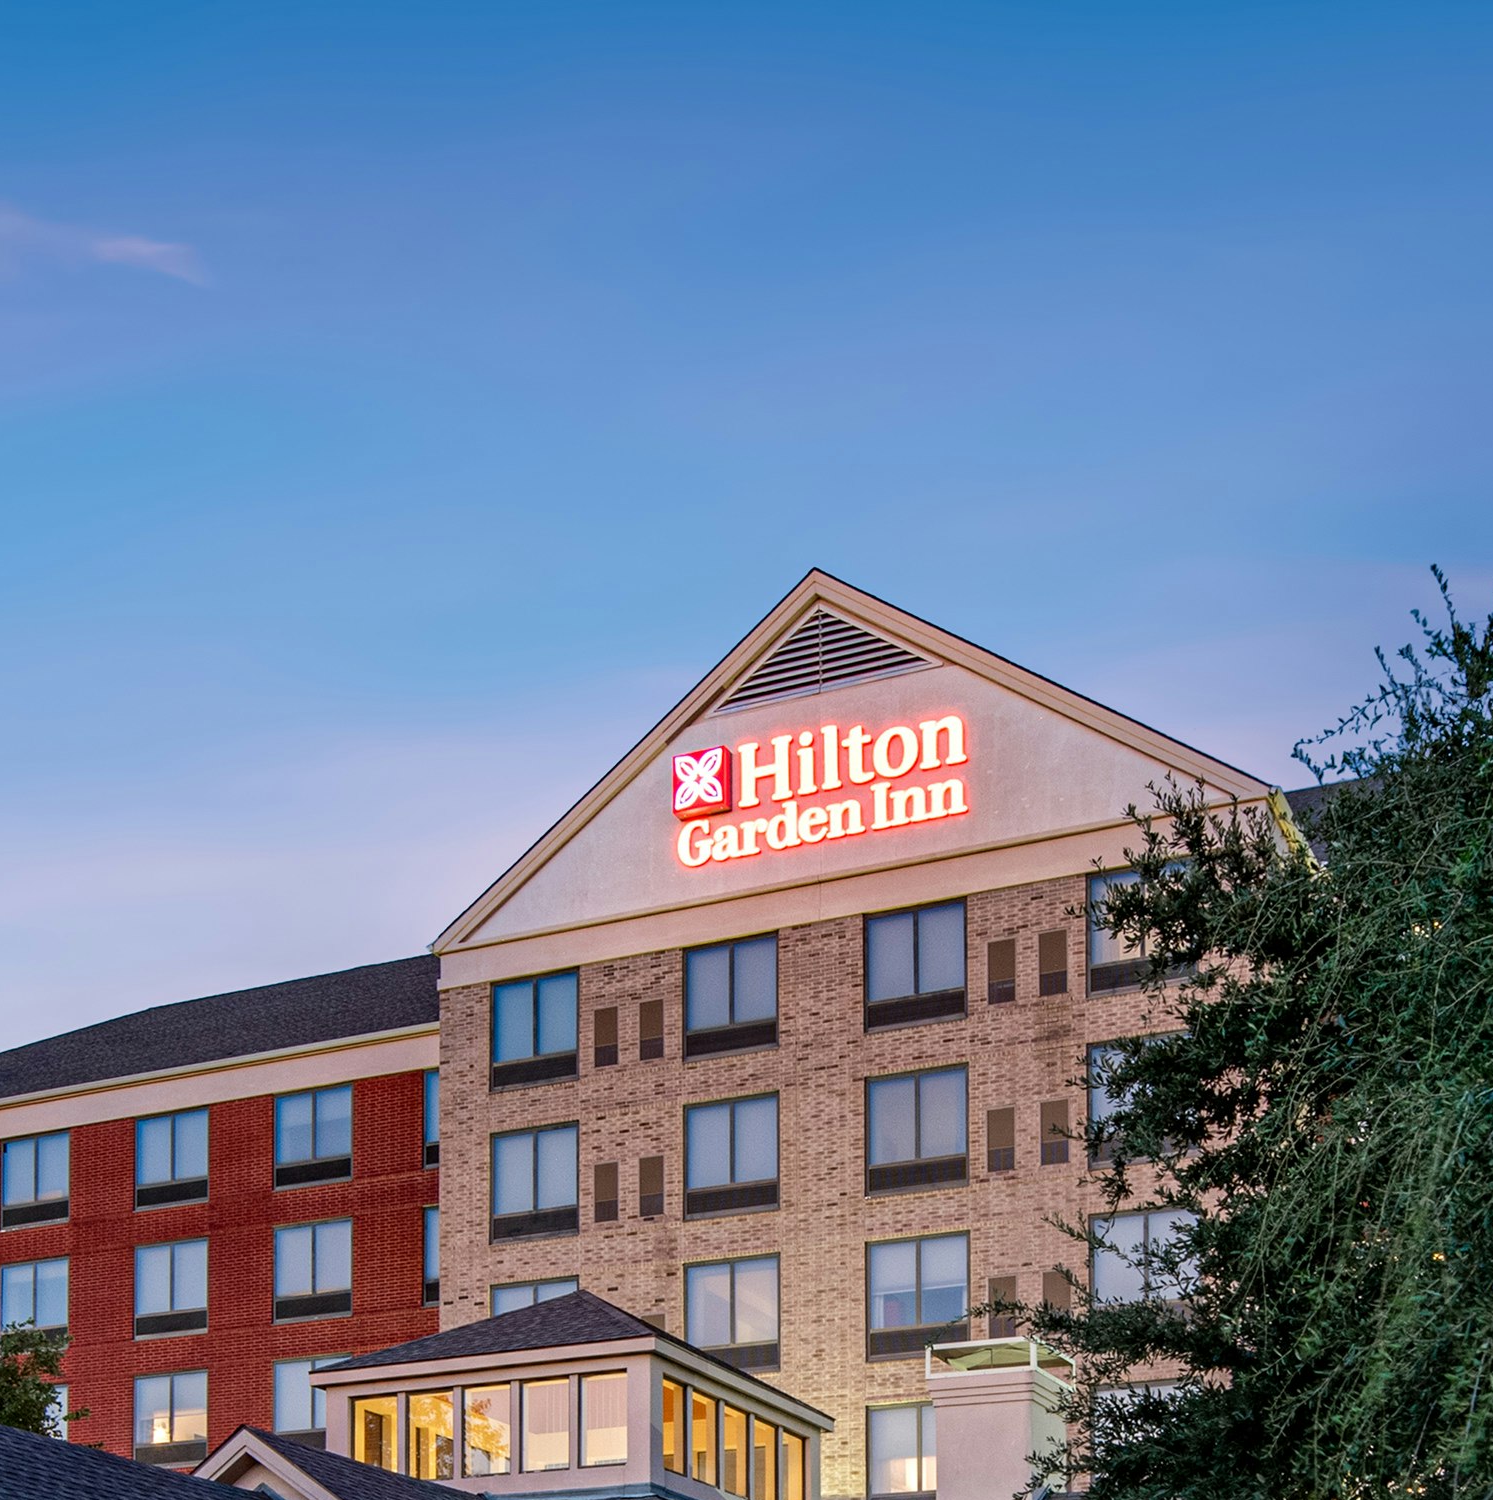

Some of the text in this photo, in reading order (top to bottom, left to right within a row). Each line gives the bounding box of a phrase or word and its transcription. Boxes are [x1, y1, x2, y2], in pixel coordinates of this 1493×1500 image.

[737, 714, 969, 807] Hilton
[677, 778, 969, 867] Garden Inn
